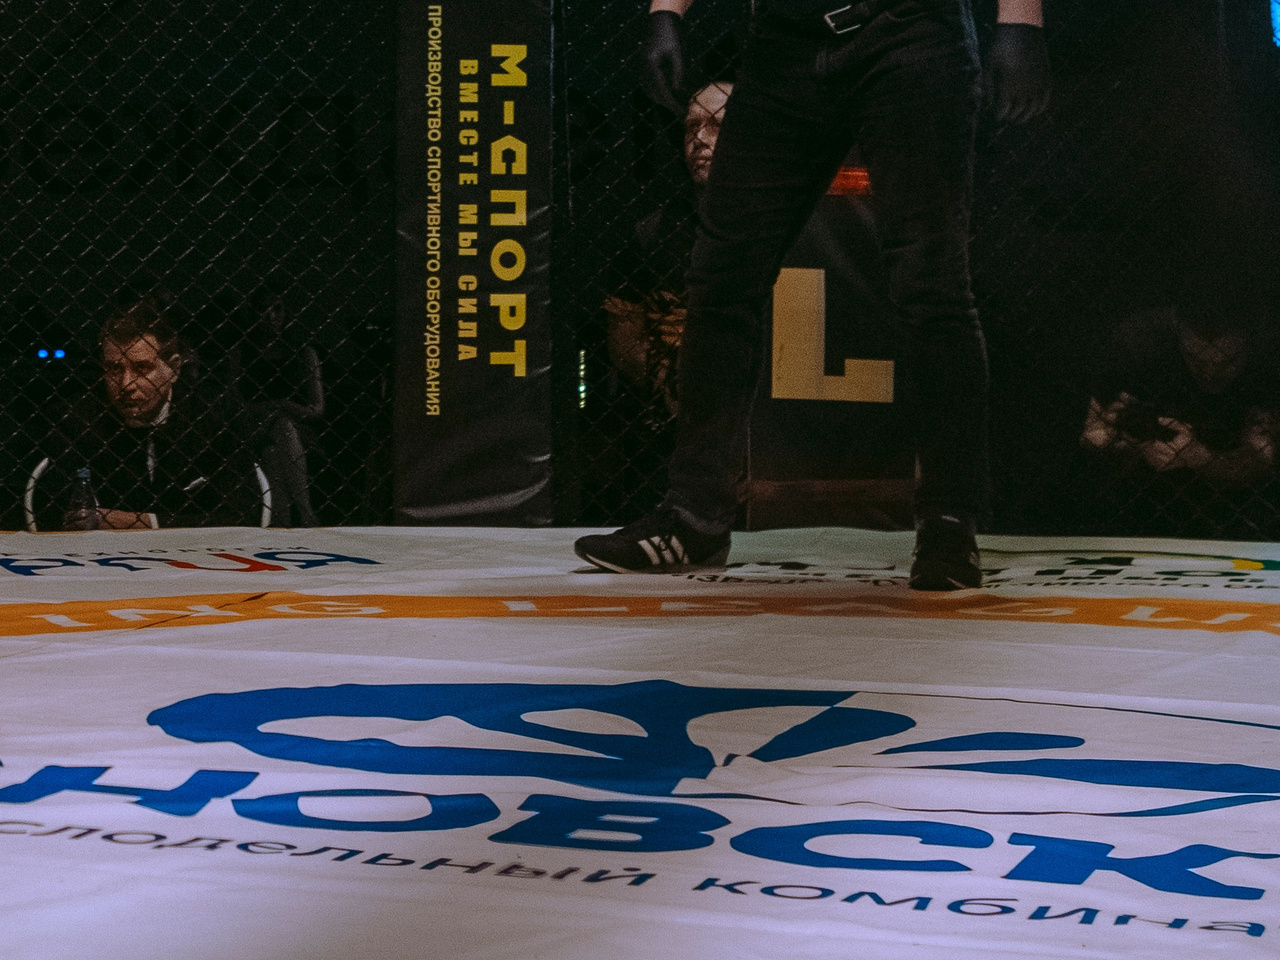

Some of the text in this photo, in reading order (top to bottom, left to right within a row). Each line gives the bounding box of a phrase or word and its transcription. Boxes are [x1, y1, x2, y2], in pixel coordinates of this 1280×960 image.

[423, 4, 443, 417] ПРОИЗВОДСТВО СПОРТИВНОГО ОБОРУДОВАНИЯ
[457, 59, 480, 362] ВМЕСТЕ МЫ СИЛА
[489, 43, 529, 378] М-СПОРТ
[503, 600, 1280, 630] LEAGU
